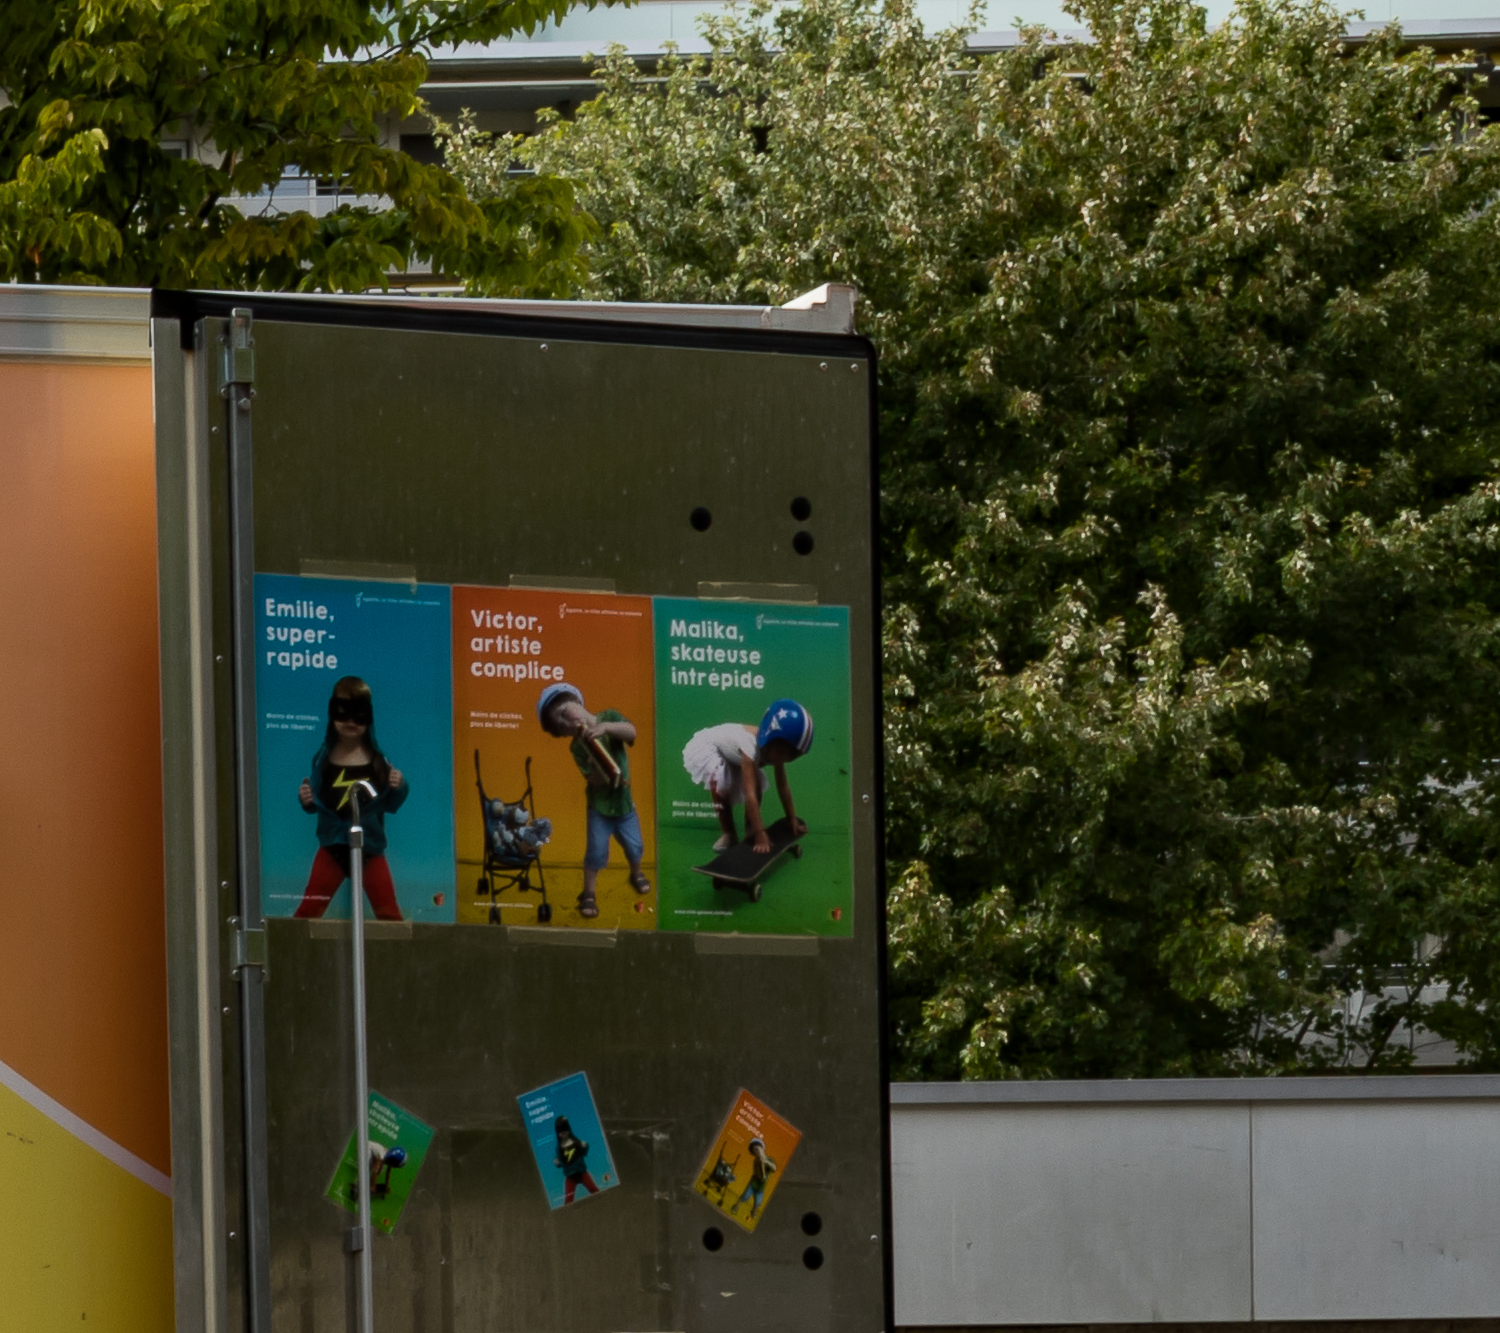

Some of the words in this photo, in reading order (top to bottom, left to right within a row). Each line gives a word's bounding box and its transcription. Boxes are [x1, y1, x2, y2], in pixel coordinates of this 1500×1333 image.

[264, 597, 336, 623] Emilie,
[470, 608, 544, 634] Victor,
[265, 624, 337, 647] super-
[669, 618, 745, 643] Malika,
[470, 634, 542, 656] artiste
[670, 643, 762, 665] skateuse
[265, 649, 339, 672] rapide
[470, 660, 565, 683] complice
[671, 666, 766, 691] intrépide
